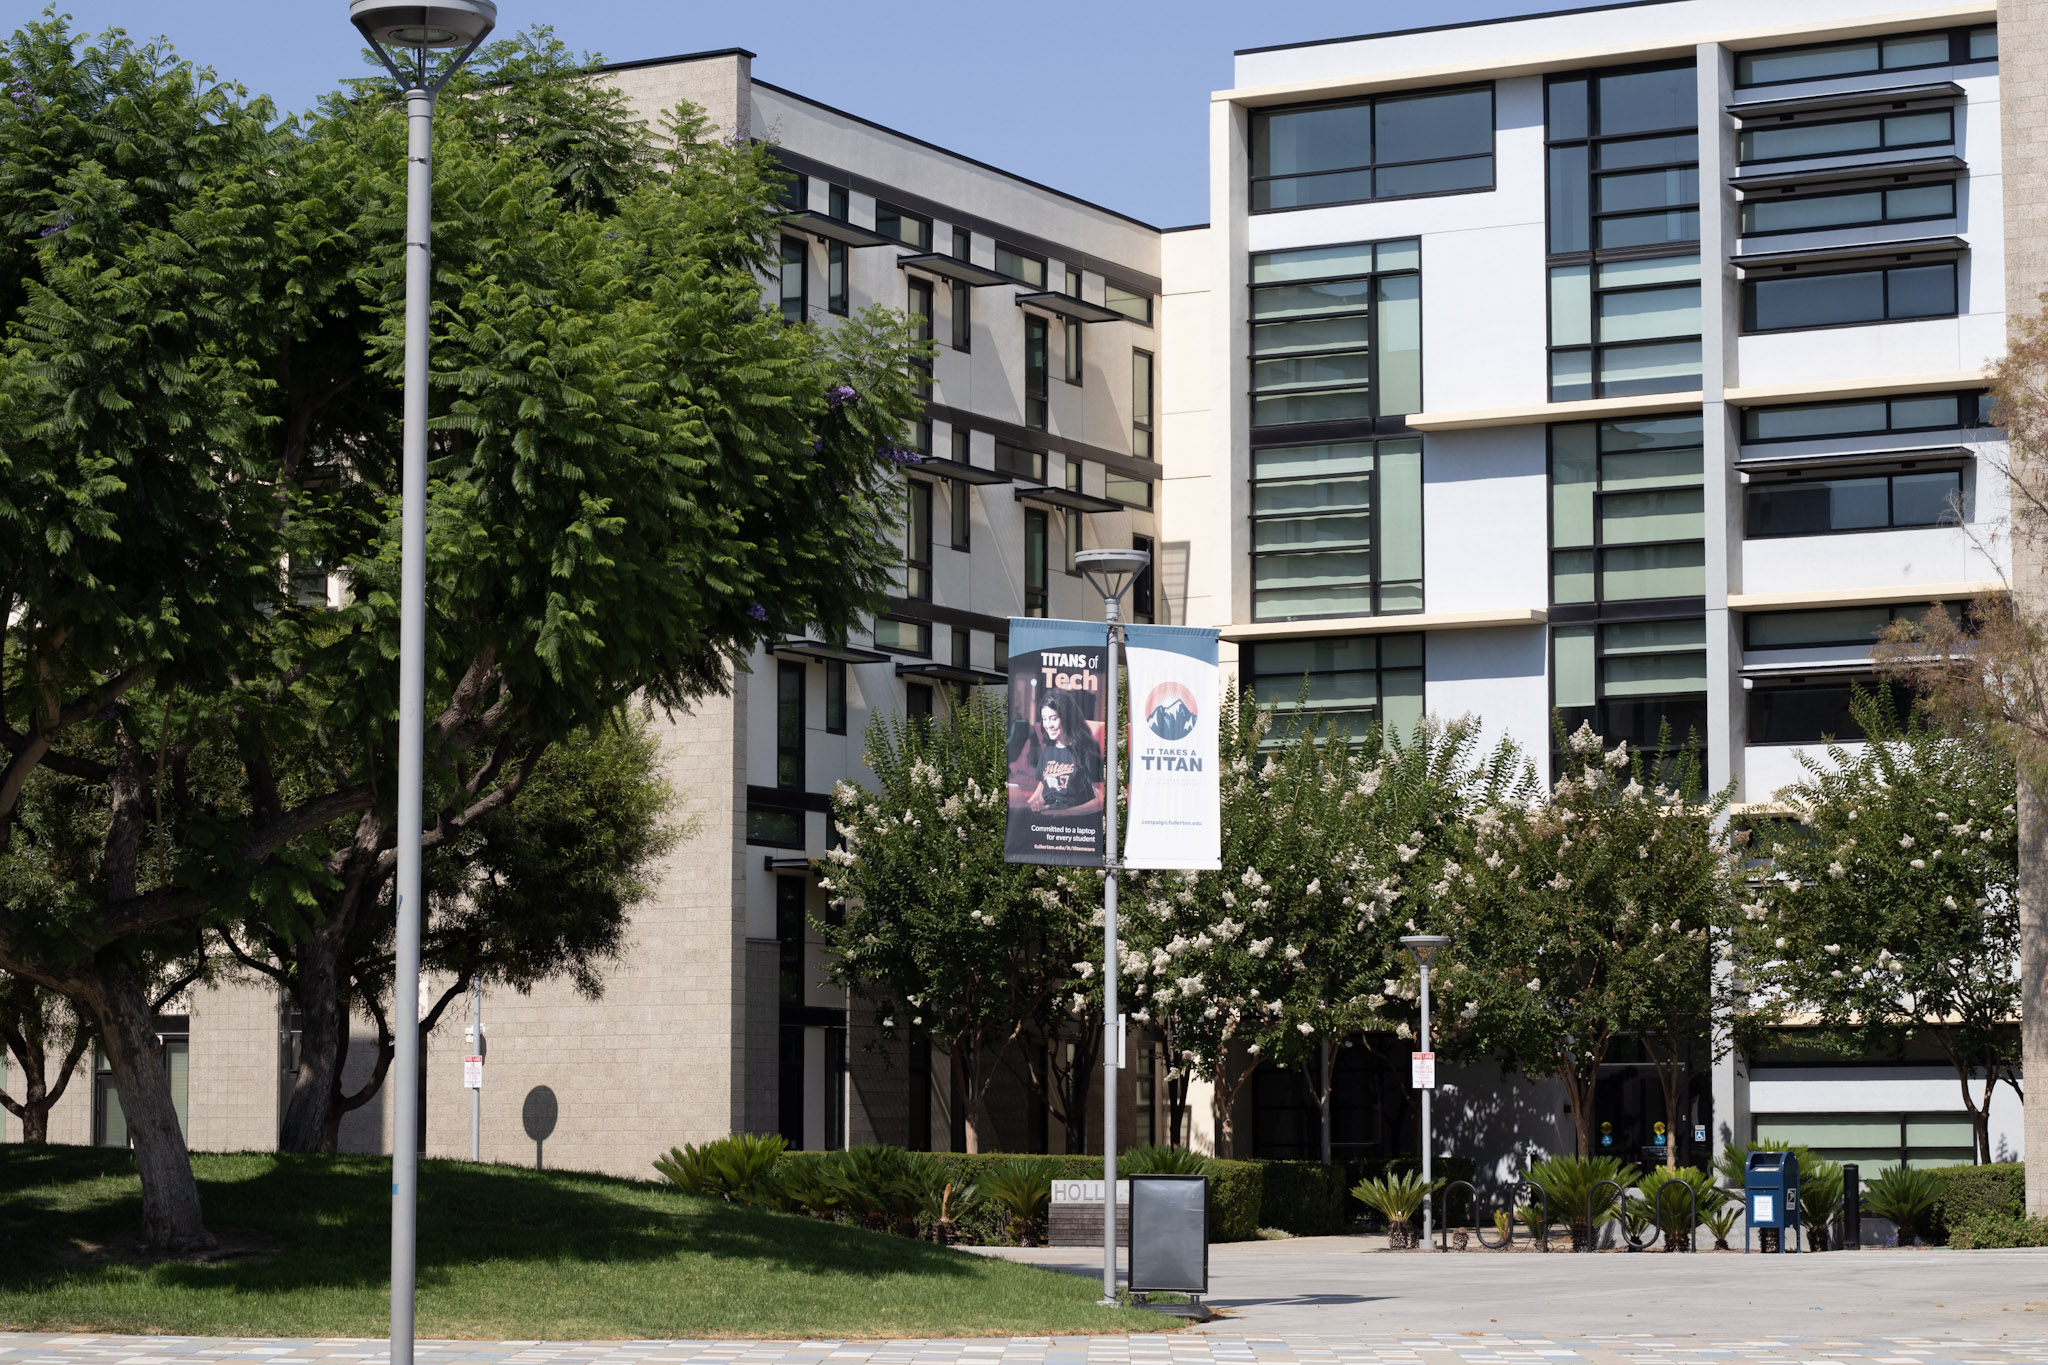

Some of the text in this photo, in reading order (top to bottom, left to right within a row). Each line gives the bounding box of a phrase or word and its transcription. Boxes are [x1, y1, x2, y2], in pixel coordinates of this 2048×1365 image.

[1041, 652, 1099, 669] TITANS of
[1041, 667, 1098, 691] Tech
[1159, 748, 1188, 756] TAKES
[1141, 756, 1202, 772] TITAN
[1030, 824, 1064, 833] Committed
[1077, 827, 1096, 835] laptop
[1054, 1183, 1105, 1201] HOLL
